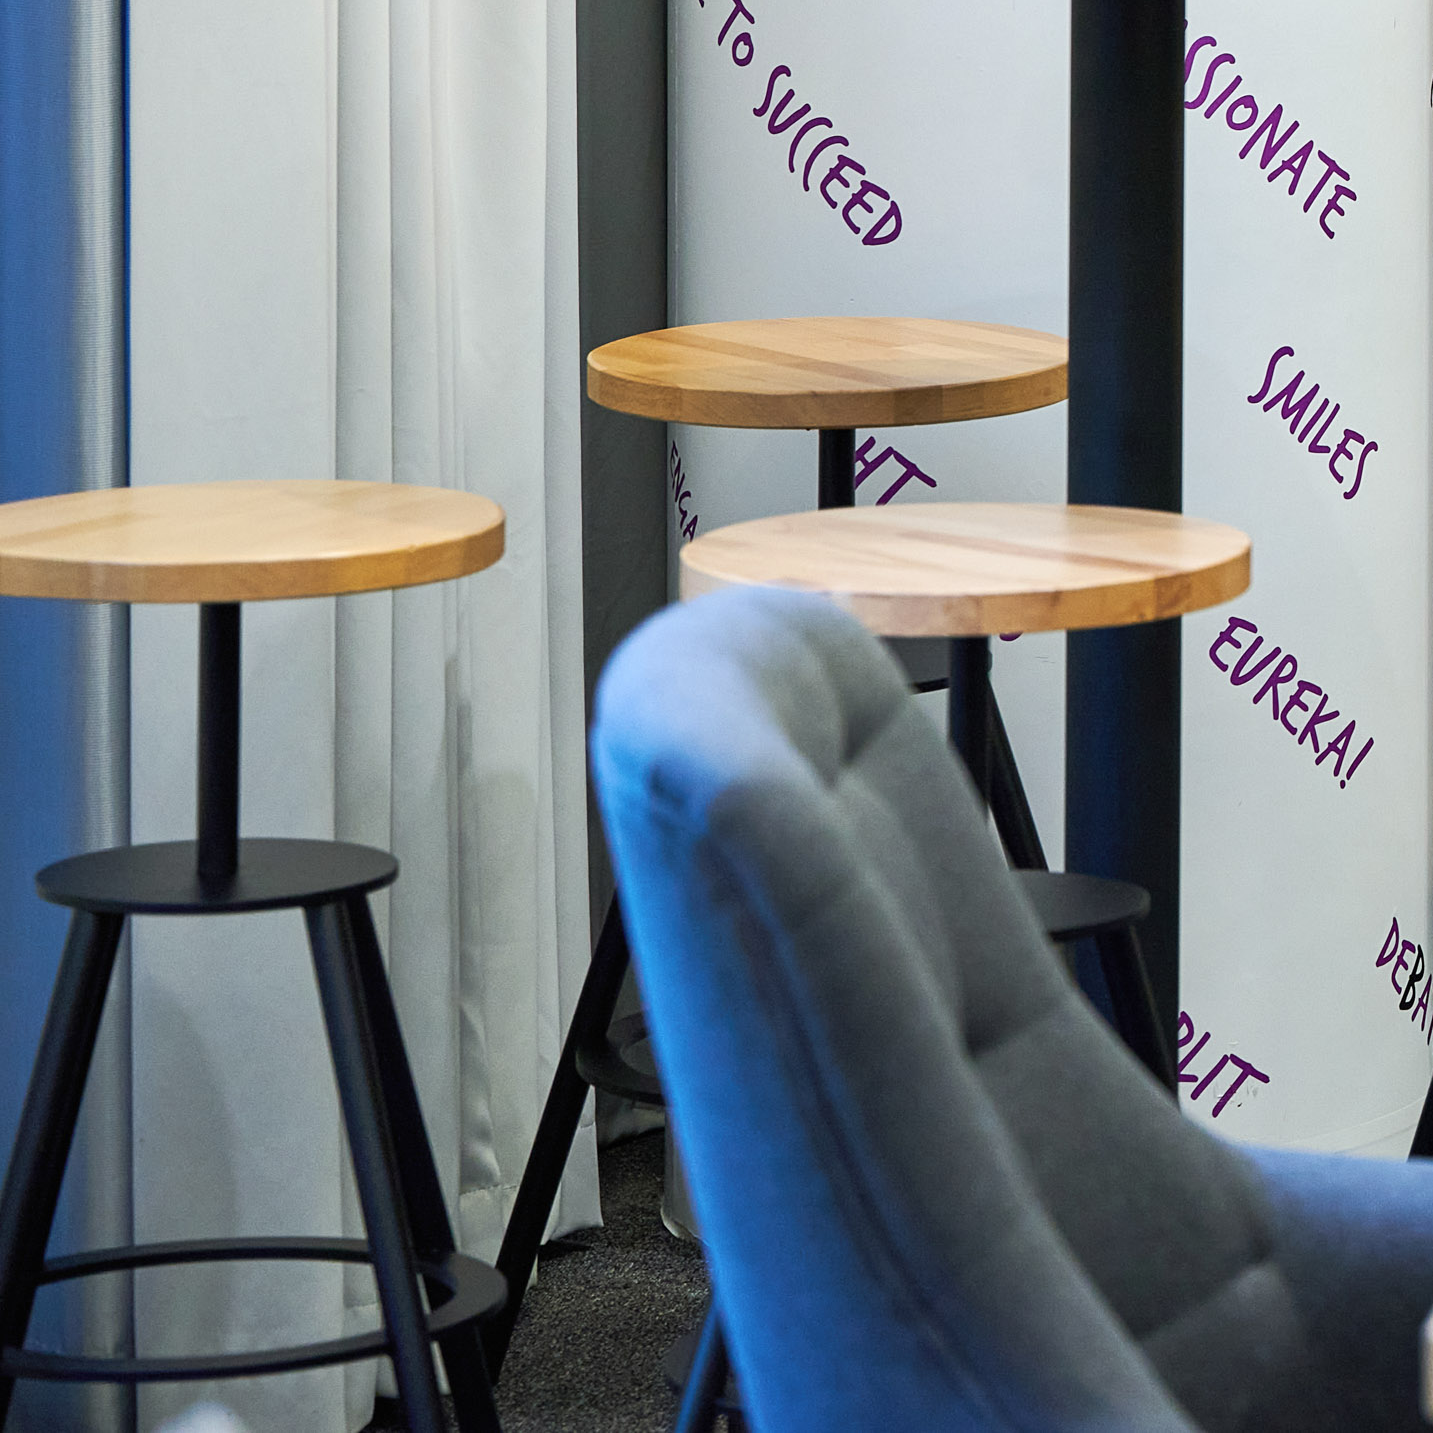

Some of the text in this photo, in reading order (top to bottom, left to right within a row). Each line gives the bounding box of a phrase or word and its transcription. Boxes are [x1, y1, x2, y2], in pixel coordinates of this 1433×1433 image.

[752, 64, 903, 246] SUCCEED
[1184, 19, 1358, 240] SSIONATE
[670, 439, 699, 543] ENGA
[1246, 345, 1379, 500] SMILES
[1208, 616, 1375, 790] EUREKA!
